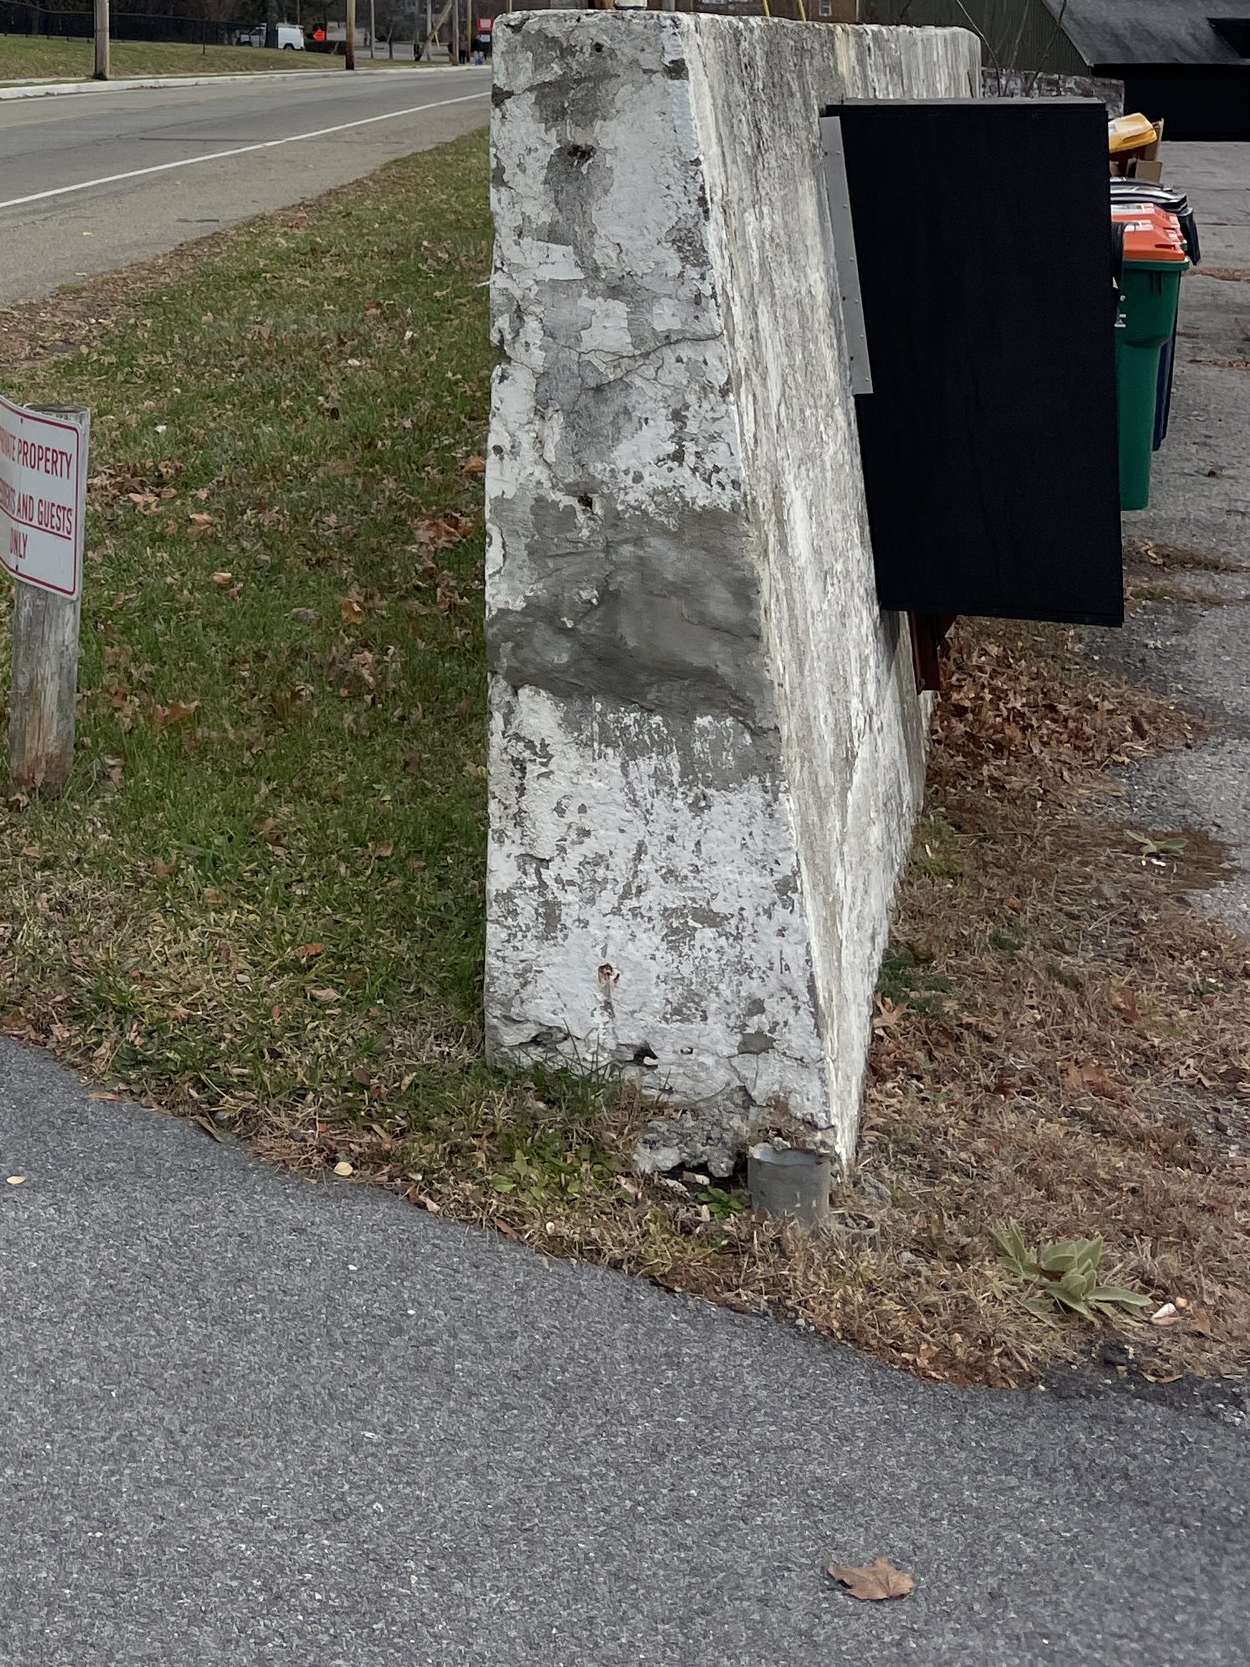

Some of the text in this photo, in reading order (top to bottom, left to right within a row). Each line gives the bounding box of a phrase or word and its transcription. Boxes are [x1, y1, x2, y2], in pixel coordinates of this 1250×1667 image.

[17, 438, 73, 480] PROPERTY
[16, 491, 34, 522] AND
[37, 498, 73, 536] GUESTS
[9, 527, 28, 560] ONLY
